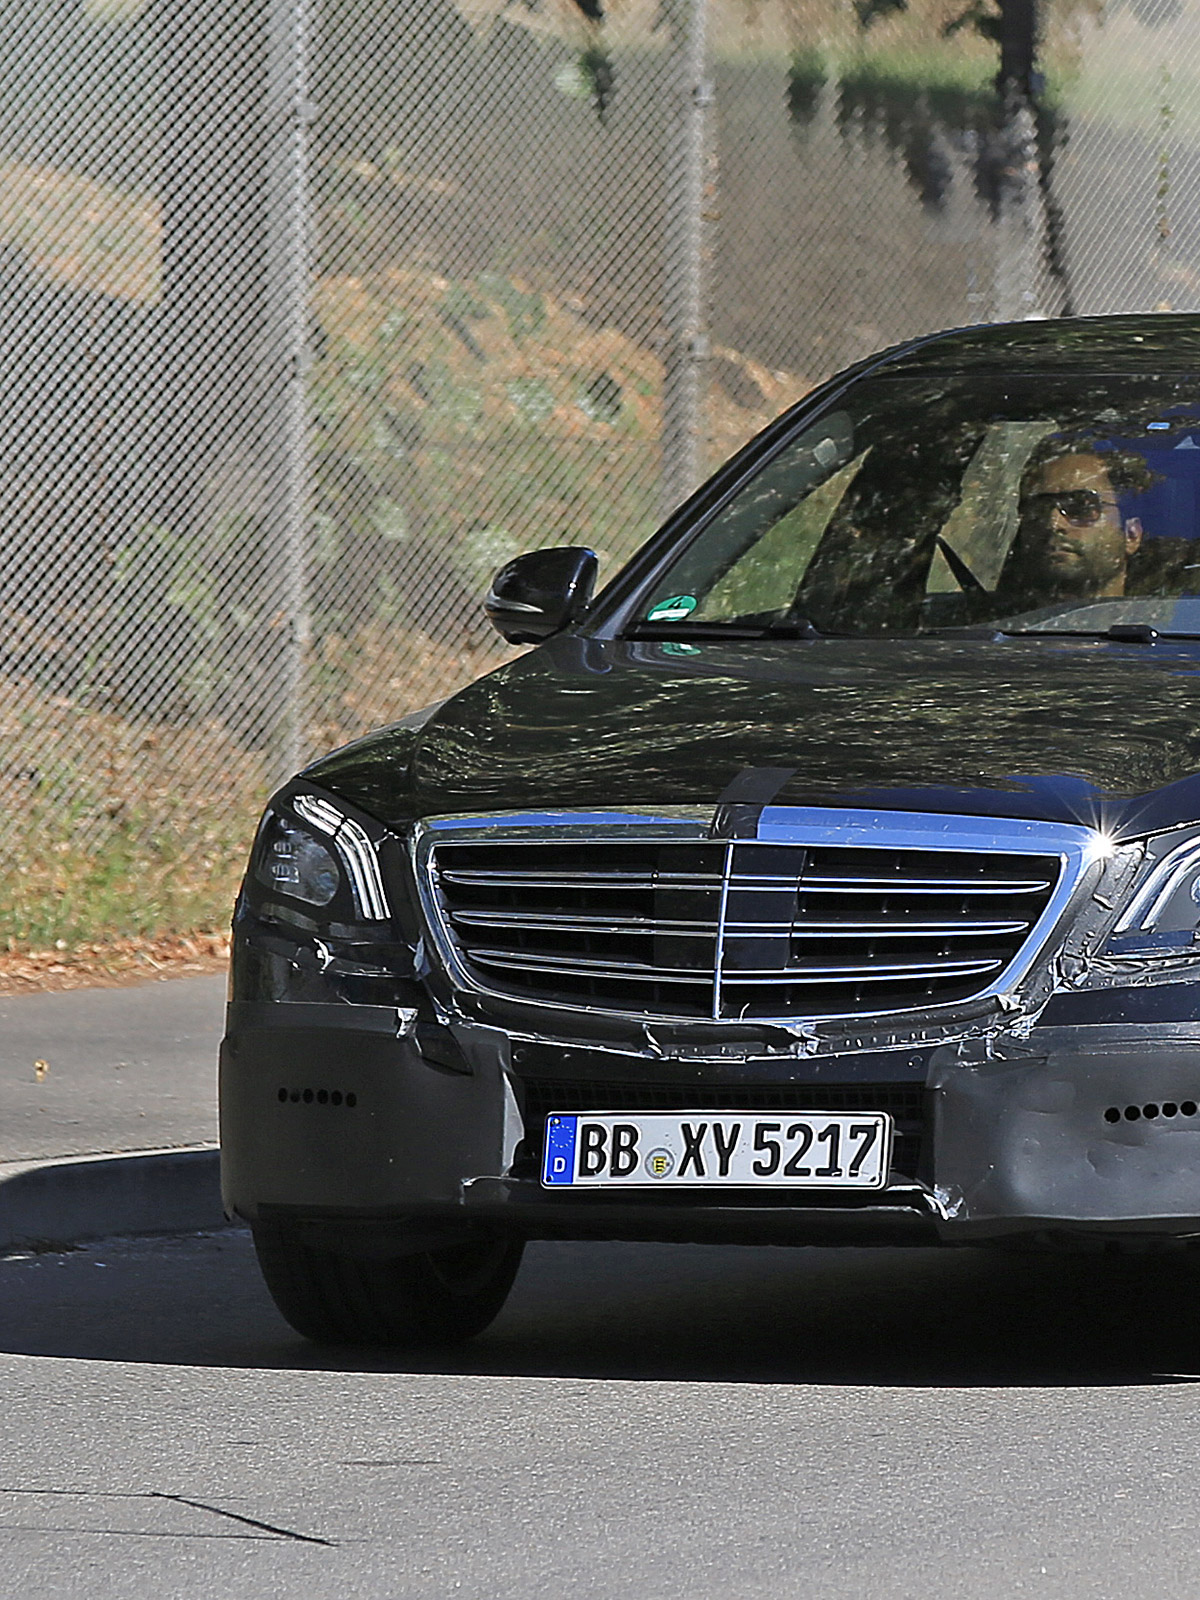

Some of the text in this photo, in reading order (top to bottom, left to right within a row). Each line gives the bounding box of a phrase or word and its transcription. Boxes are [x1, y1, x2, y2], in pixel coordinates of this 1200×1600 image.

[553, 1157, 566, 1173] D
[579, 1122, 878, 1177] BB XY 5217
